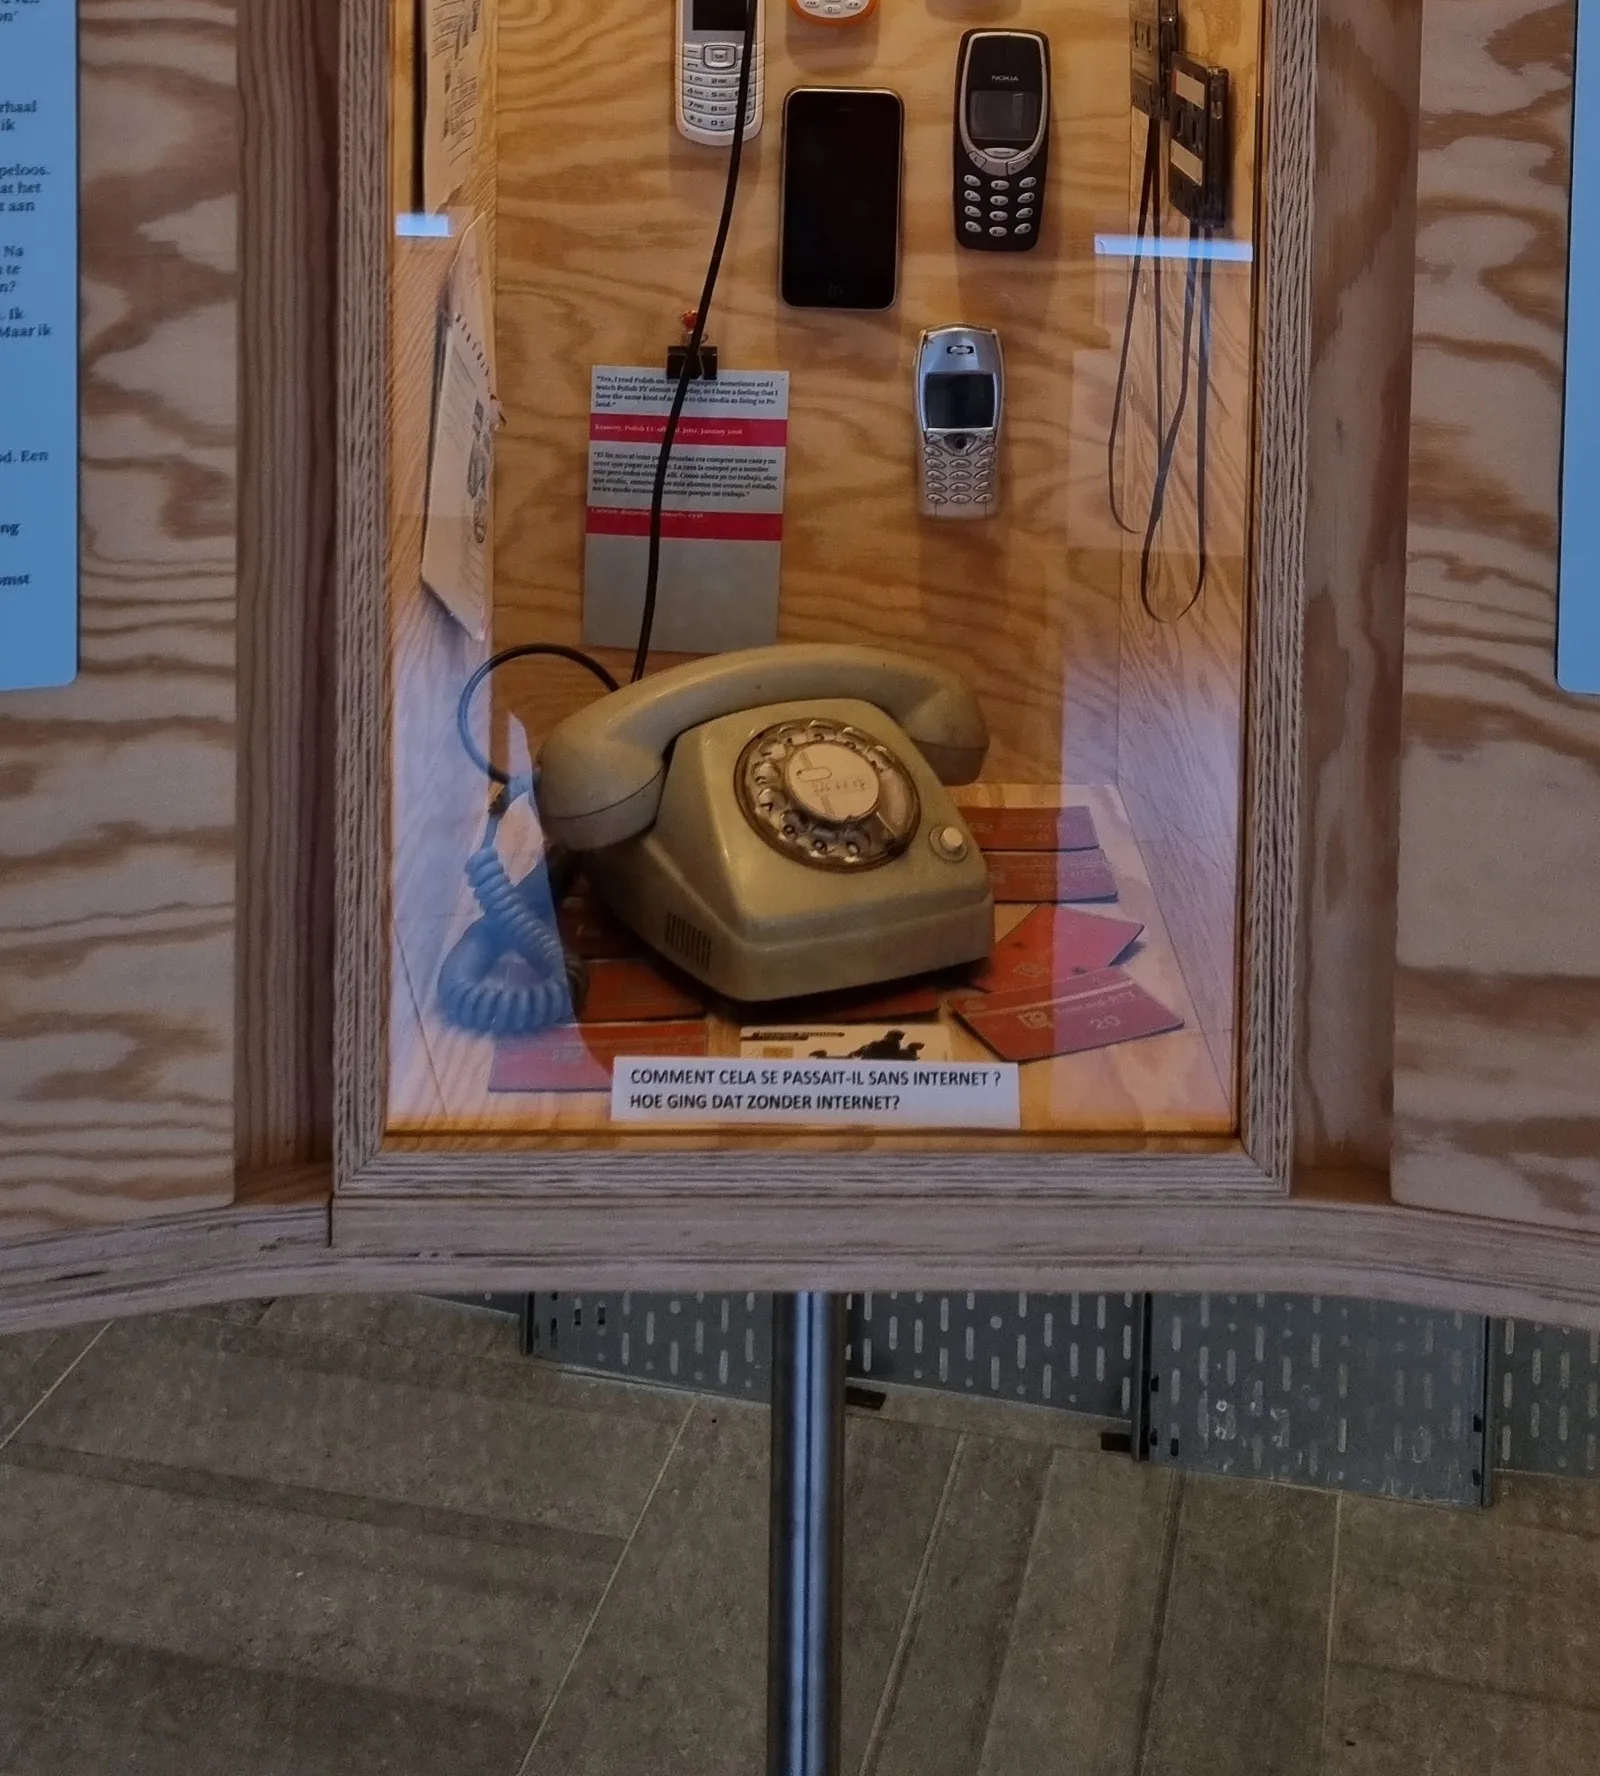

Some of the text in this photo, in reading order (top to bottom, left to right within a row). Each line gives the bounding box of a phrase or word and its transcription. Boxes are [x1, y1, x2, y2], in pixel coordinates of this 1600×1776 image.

[630, 1068, 1002, 1086] COMMENT CELA SE PASSAIT-IL SANS INTERNET ?
[630, 1093, 901, 1111] HOE GING DAT ZONDER INTERNET?
